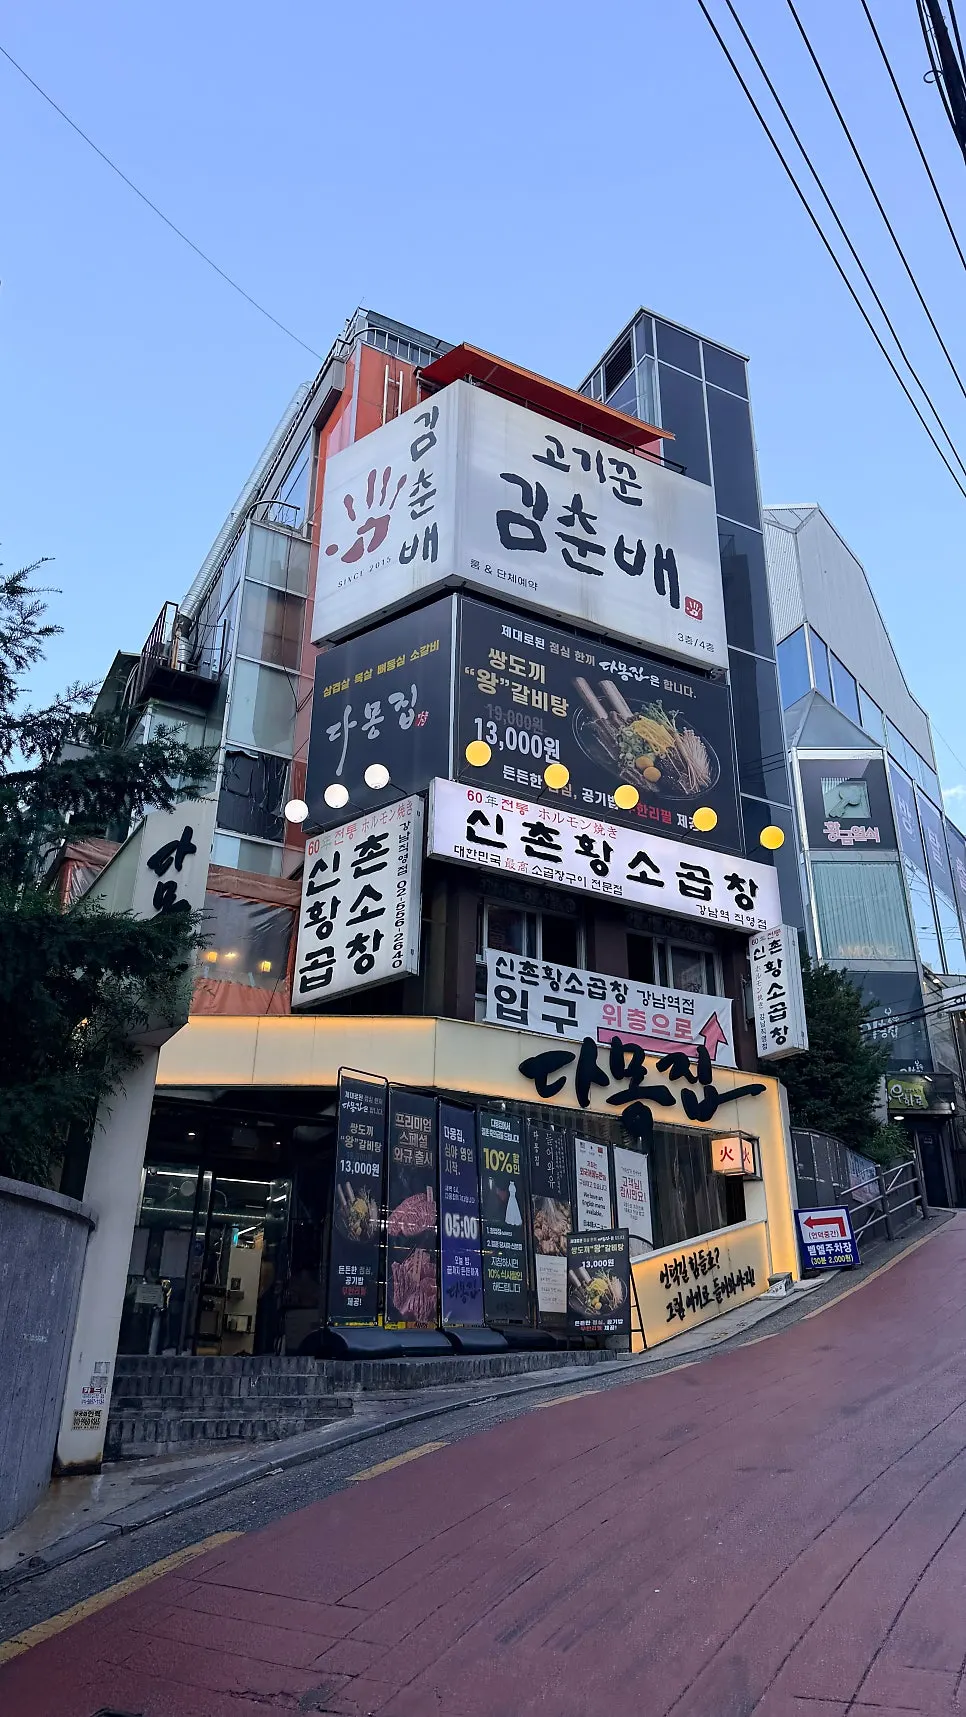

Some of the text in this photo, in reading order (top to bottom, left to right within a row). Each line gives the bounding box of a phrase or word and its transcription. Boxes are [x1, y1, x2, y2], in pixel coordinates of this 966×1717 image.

[398, 405, 441, 565] 김춘배
[532, 434, 643, 507] 고기꾼
[495, 472, 682, 610] 김춘배
[496, 567, 539, 592] 단체예약
[677, 632, 715, 653] 3층/4층
[323, 639, 440, 698] 삼겹살 목살 뼈등심 소갈비
[488, 647, 546, 685] 쌍도끼
[501, 624, 545, 650] 제대로된
[549, 641, 570, 658] 점심
[574, 650, 595, 666] 한끼
[663, 679, 697, 699] 합니다.
[325, 683, 418, 777] 다몽집
[474, 717, 560, 764] 13,000원
[502, 764, 543, 789] 든든한
[333, 823, 357, 846] 전통
[362, 800, 413, 833] ホルモン焼き
[501, 798, 529, 816] 전통
[538, 808, 618, 840] ホルモン焼き
[822, 820, 881, 846] 황금열쇠
[453, 845, 502, 867] 대한민국
[591, 878, 624, 897] 전문점
[465, 809, 759, 912] 신촌황소곱창
[391, 880, 407, 969] 02-556-2640
[695, 904, 730, 922] 강남역
[734, 913, 767, 930] 직영점
[495, 956, 695, 1015] 신촌황소곱창 강남역점
[753, 938, 789, 1046] 신촌황소곱창
[494, 984, 693, 1041] 입구 위층으로
[518, 1036, 767, 1138] 다몽집
[350, 1122, 374, 1137] 쌍도끼
[395, 1113, 432, 1133] 프리미엄
[443, 1125, 465, 1143] 다몽집,
[399, 1131, 428, 1149] 스페셜
[445, 1143, 473, 1162] 심야 영업
[719, 1146, 735, 1162] 火
[340, 1159, 380, 1177] 13,000원
[393, 1147, 413, 1163] 와규
[415, 1150, 433, 1167] 출시
[483, 1147, 513, 1174] 10%
[444, 1212, 478, 1240] 05:00
[338, 1265, 357, 1275] 든든한
[488, 1269, 500, 1279] 10%
[581, 1258, 615, 1268] 13,000원
[660, 1254, 690, 1289] 언덕길
[345, 1276, 364, 1286] 공기밥
[666, 1291, 686, 1323] 그럼
